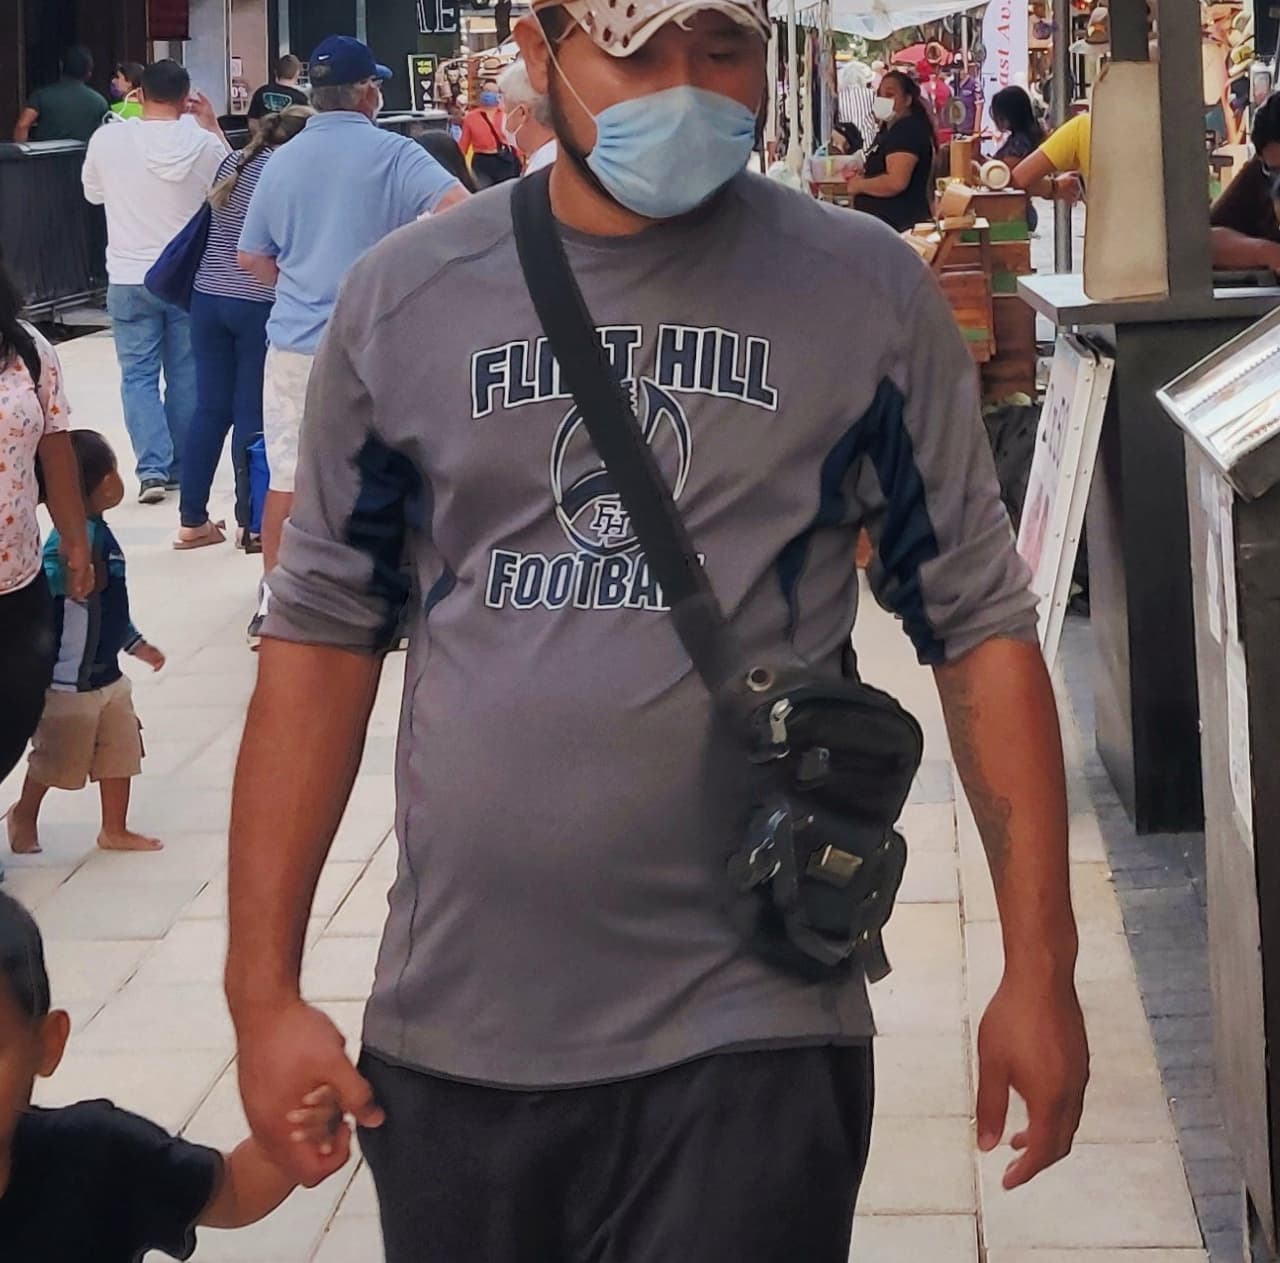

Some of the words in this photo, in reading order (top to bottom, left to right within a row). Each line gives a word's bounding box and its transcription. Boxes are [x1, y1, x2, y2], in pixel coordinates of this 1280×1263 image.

[472, 325, 641, 419] FLIT
[655, 324, 777, 411] HILL
[484, 548, 706, 611] FOOTBA
